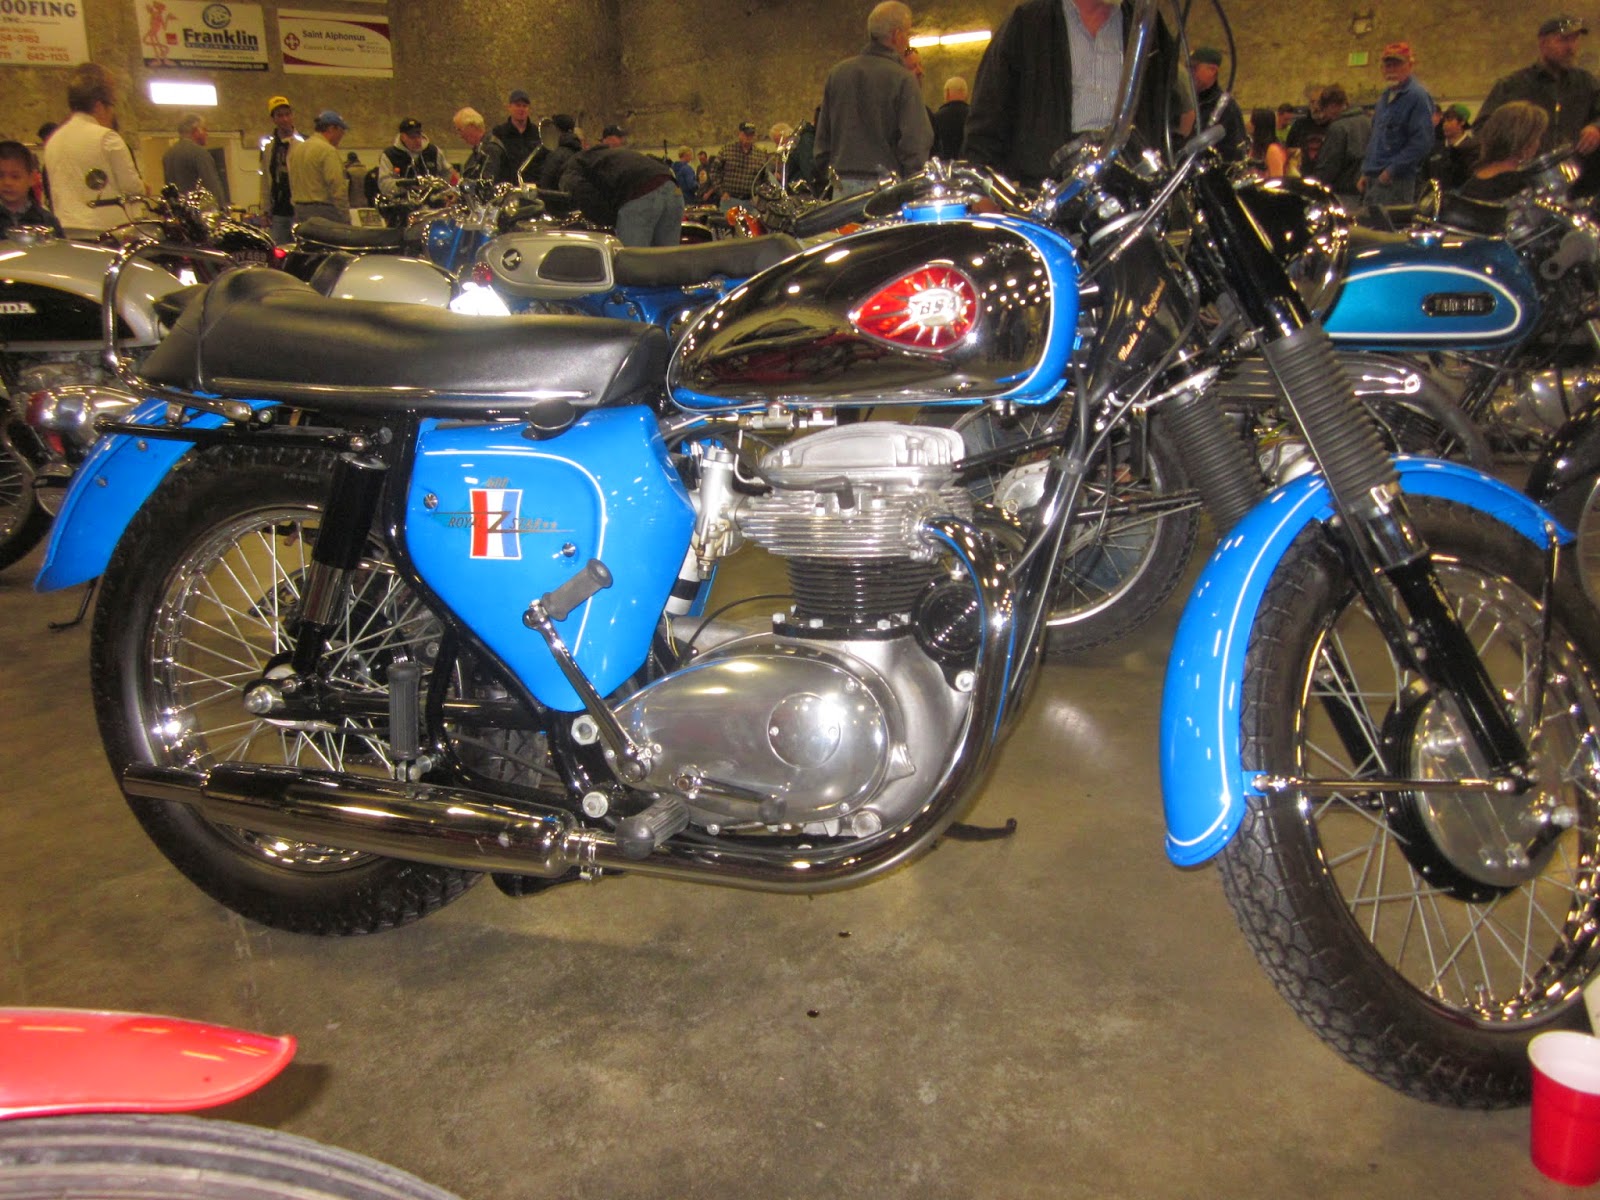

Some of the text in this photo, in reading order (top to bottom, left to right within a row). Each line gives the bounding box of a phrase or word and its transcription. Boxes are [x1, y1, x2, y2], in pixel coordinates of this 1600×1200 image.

[183, 28, 259, 46] Franklin
[302, 31, 366, 41] Saint Alphonsus
[1117, 276, 1167, 361] Made in England
[509, 517, 543, 530] STAR
